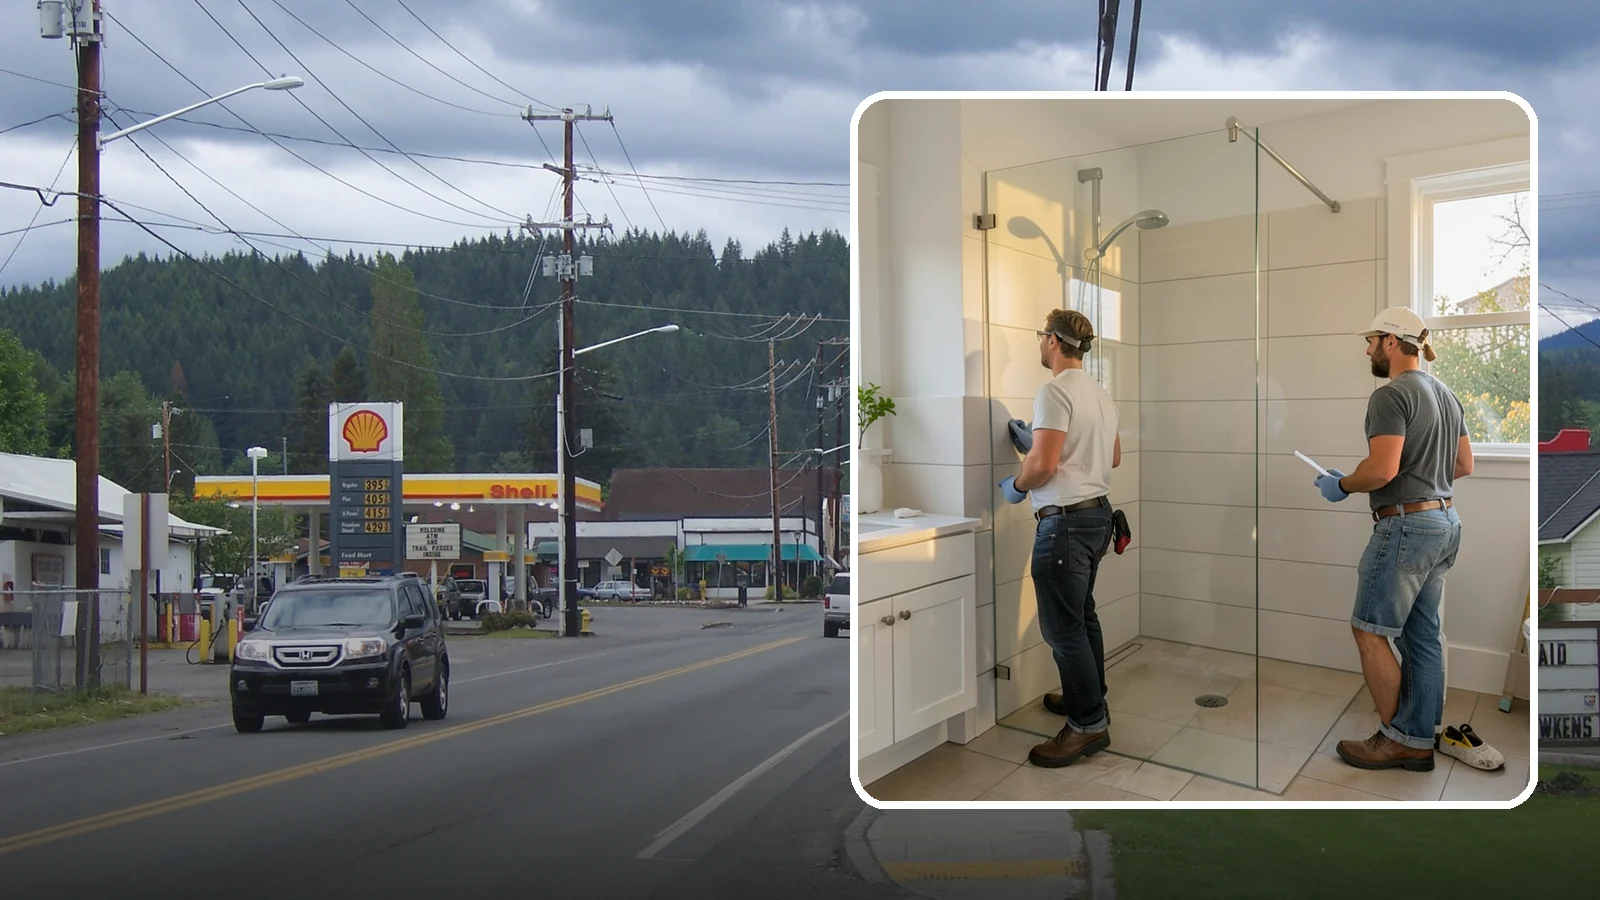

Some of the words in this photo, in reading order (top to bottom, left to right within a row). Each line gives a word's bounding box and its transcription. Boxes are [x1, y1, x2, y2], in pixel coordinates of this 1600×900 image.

[366, 480, 383, 490] 395
[490, 484, 547, 499] Shell
[365, 494, 383, 504] 405
[365, 508, 383, 518] 415
[366, 522, 383, 532] 429
[1538, 642, 1566, 665] AID
